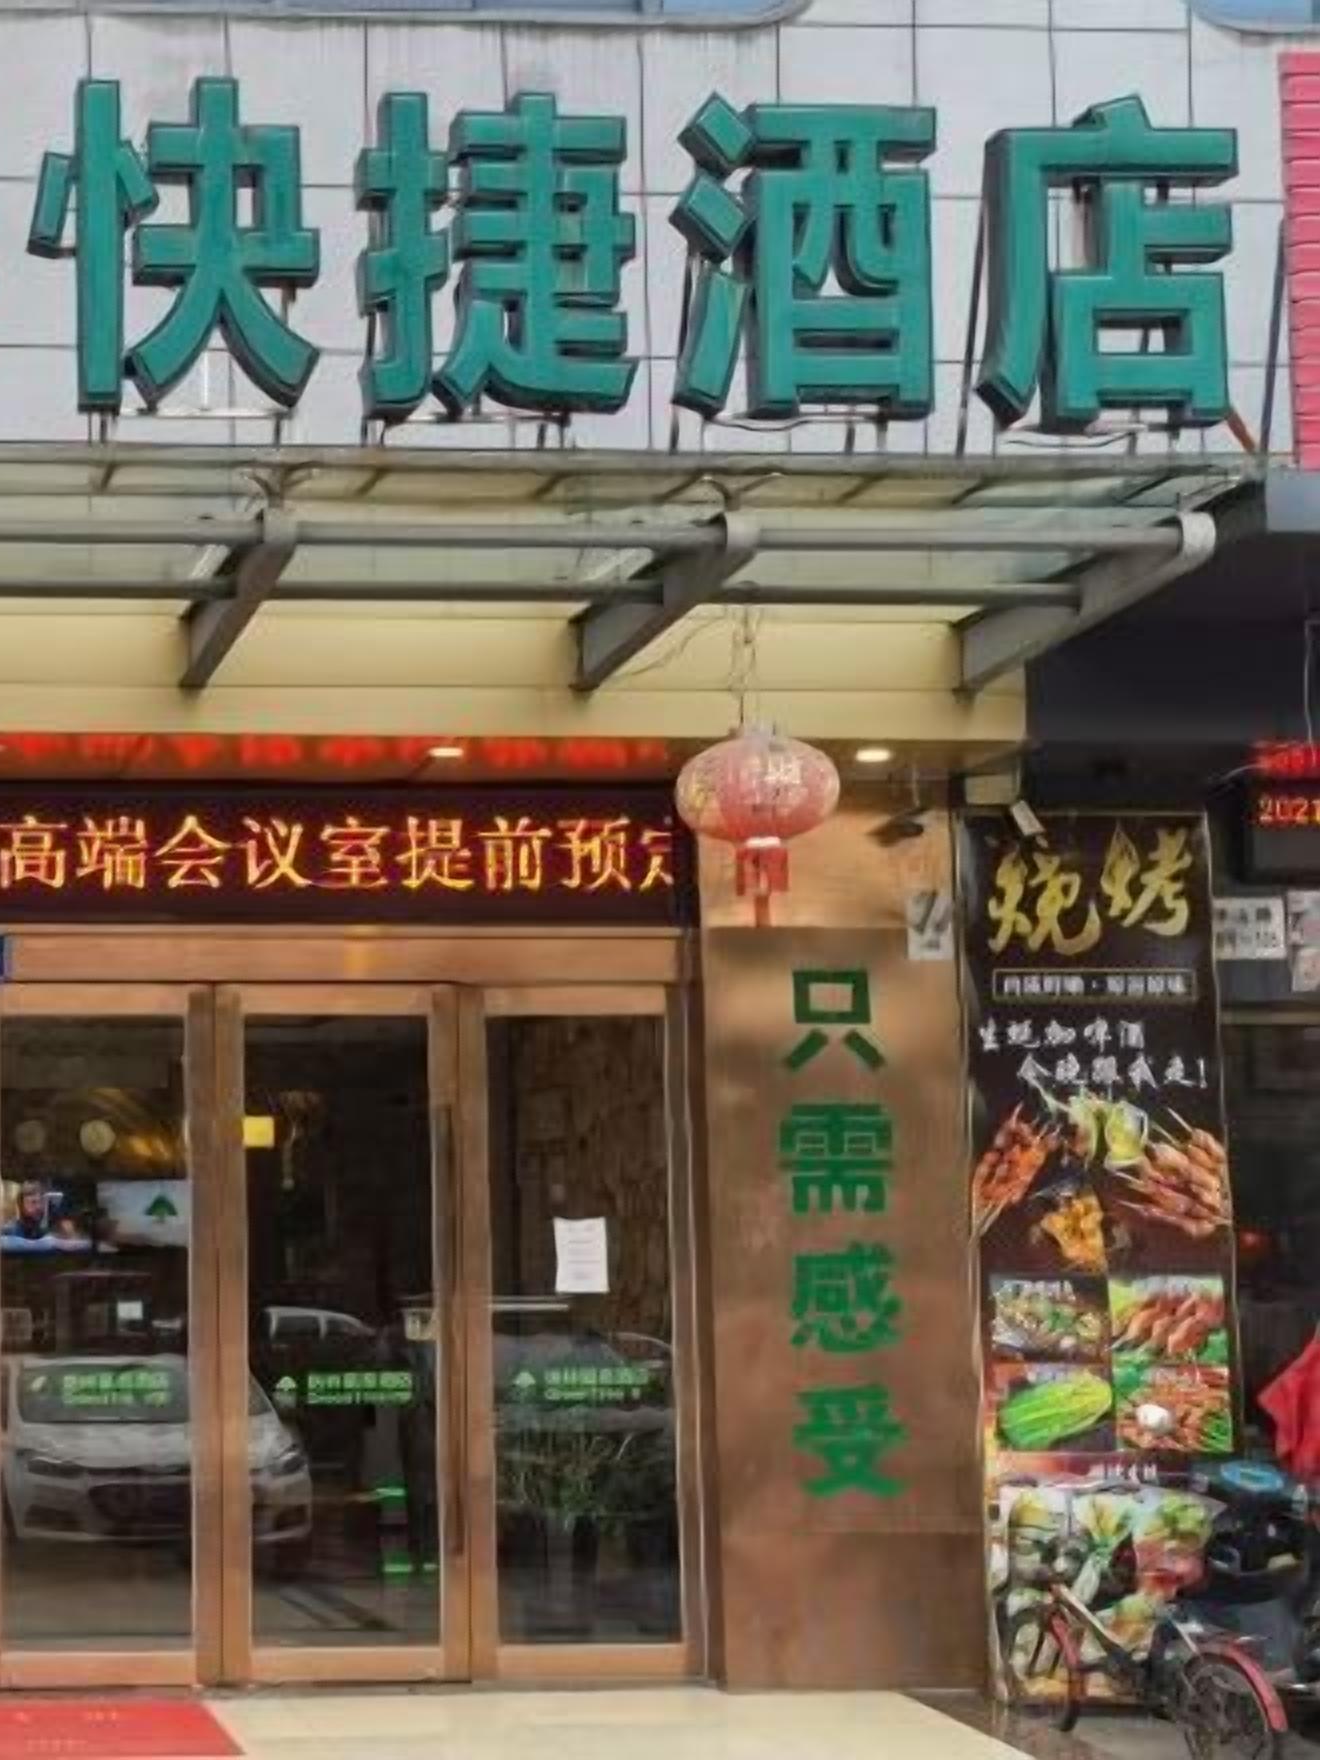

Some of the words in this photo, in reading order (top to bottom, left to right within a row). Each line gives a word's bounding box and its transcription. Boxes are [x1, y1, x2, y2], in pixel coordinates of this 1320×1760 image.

[987, 822, 1193, 956] 烧烤
[779, 967, 910, 1498] 只需感受
